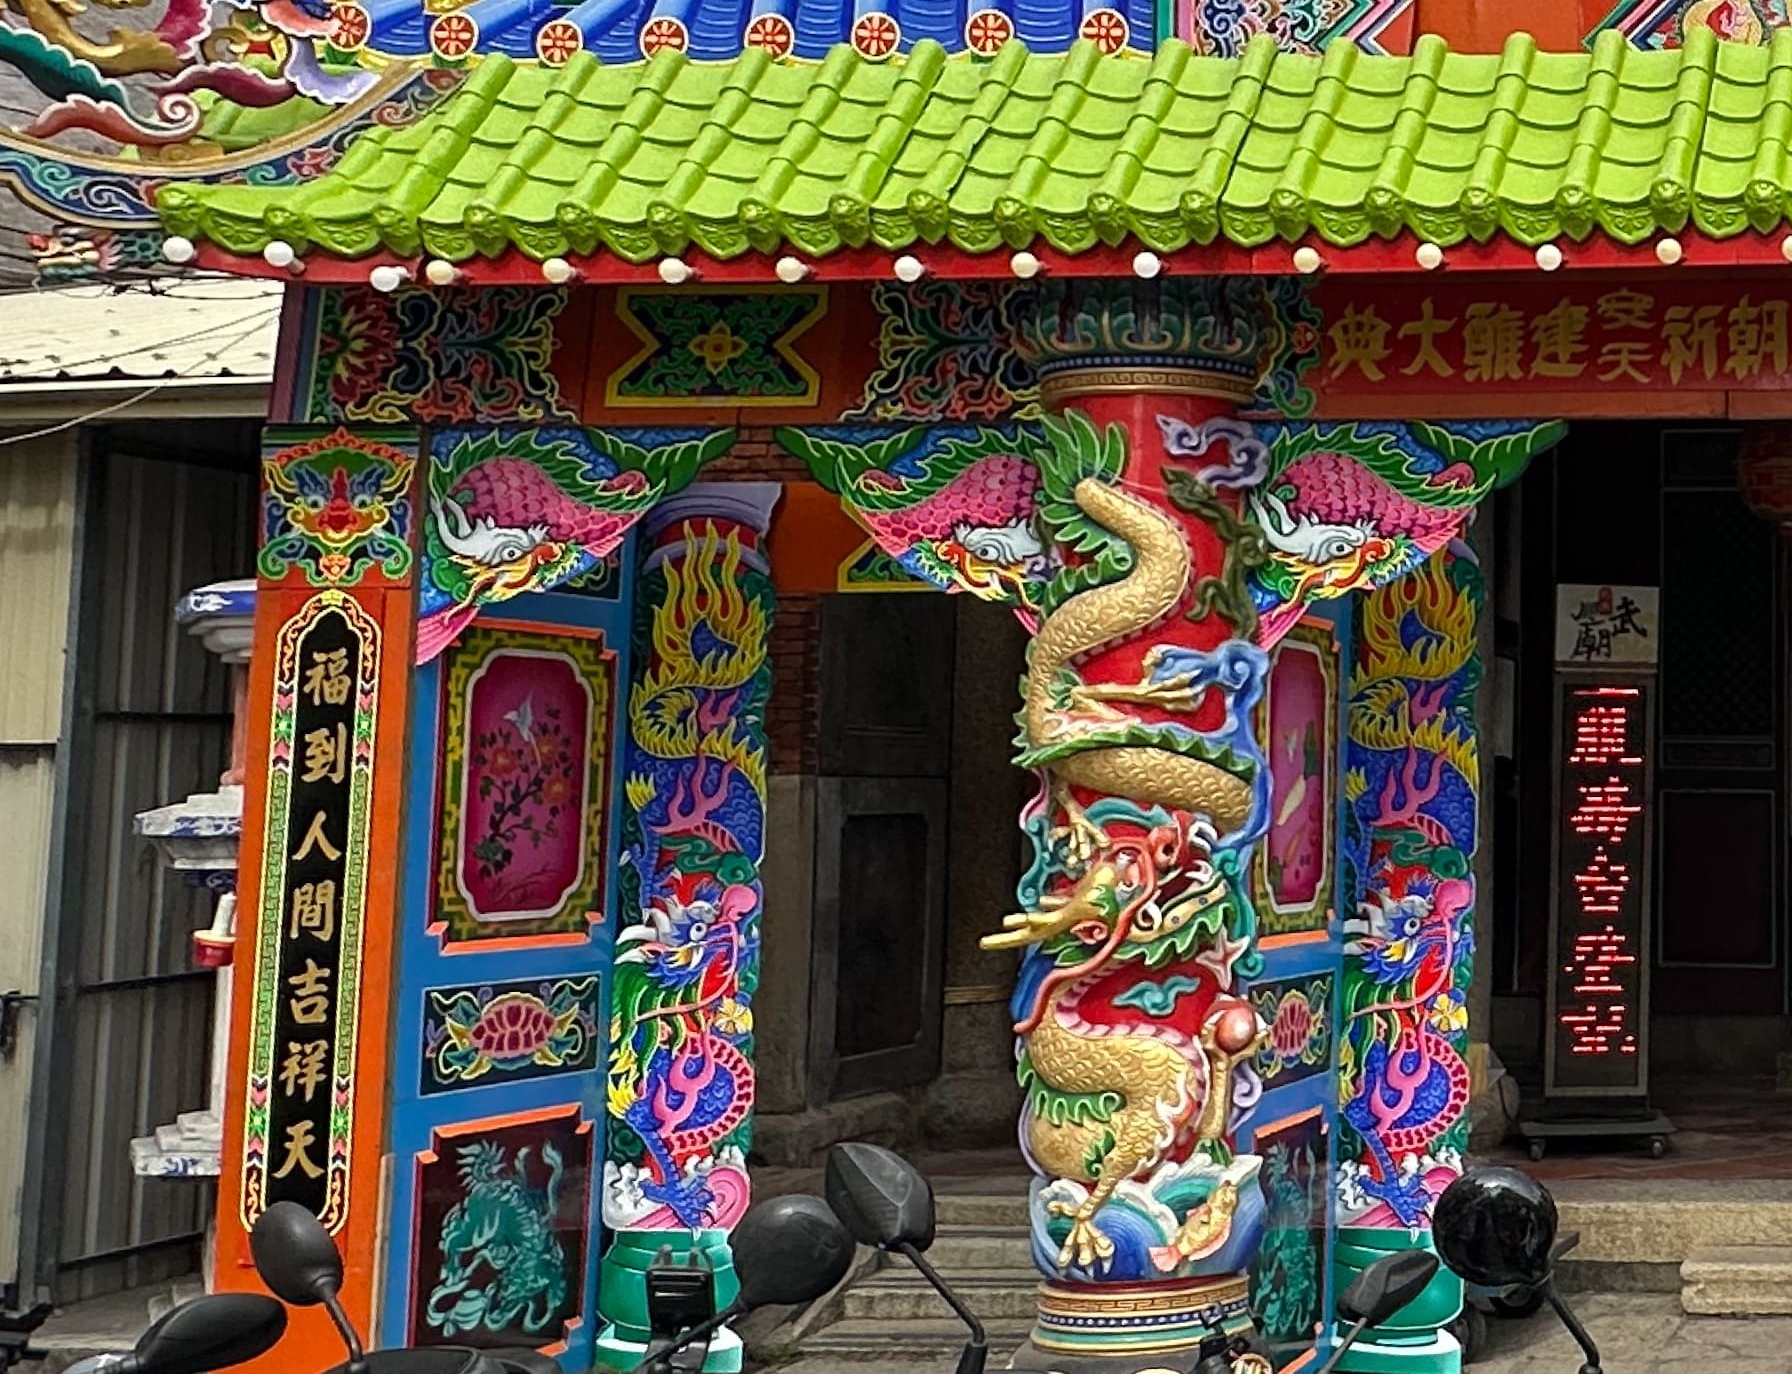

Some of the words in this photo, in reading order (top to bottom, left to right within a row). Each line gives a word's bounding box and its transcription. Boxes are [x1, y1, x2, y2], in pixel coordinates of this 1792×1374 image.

[270, 647, 351, 1180] 福到人間吉祥天
